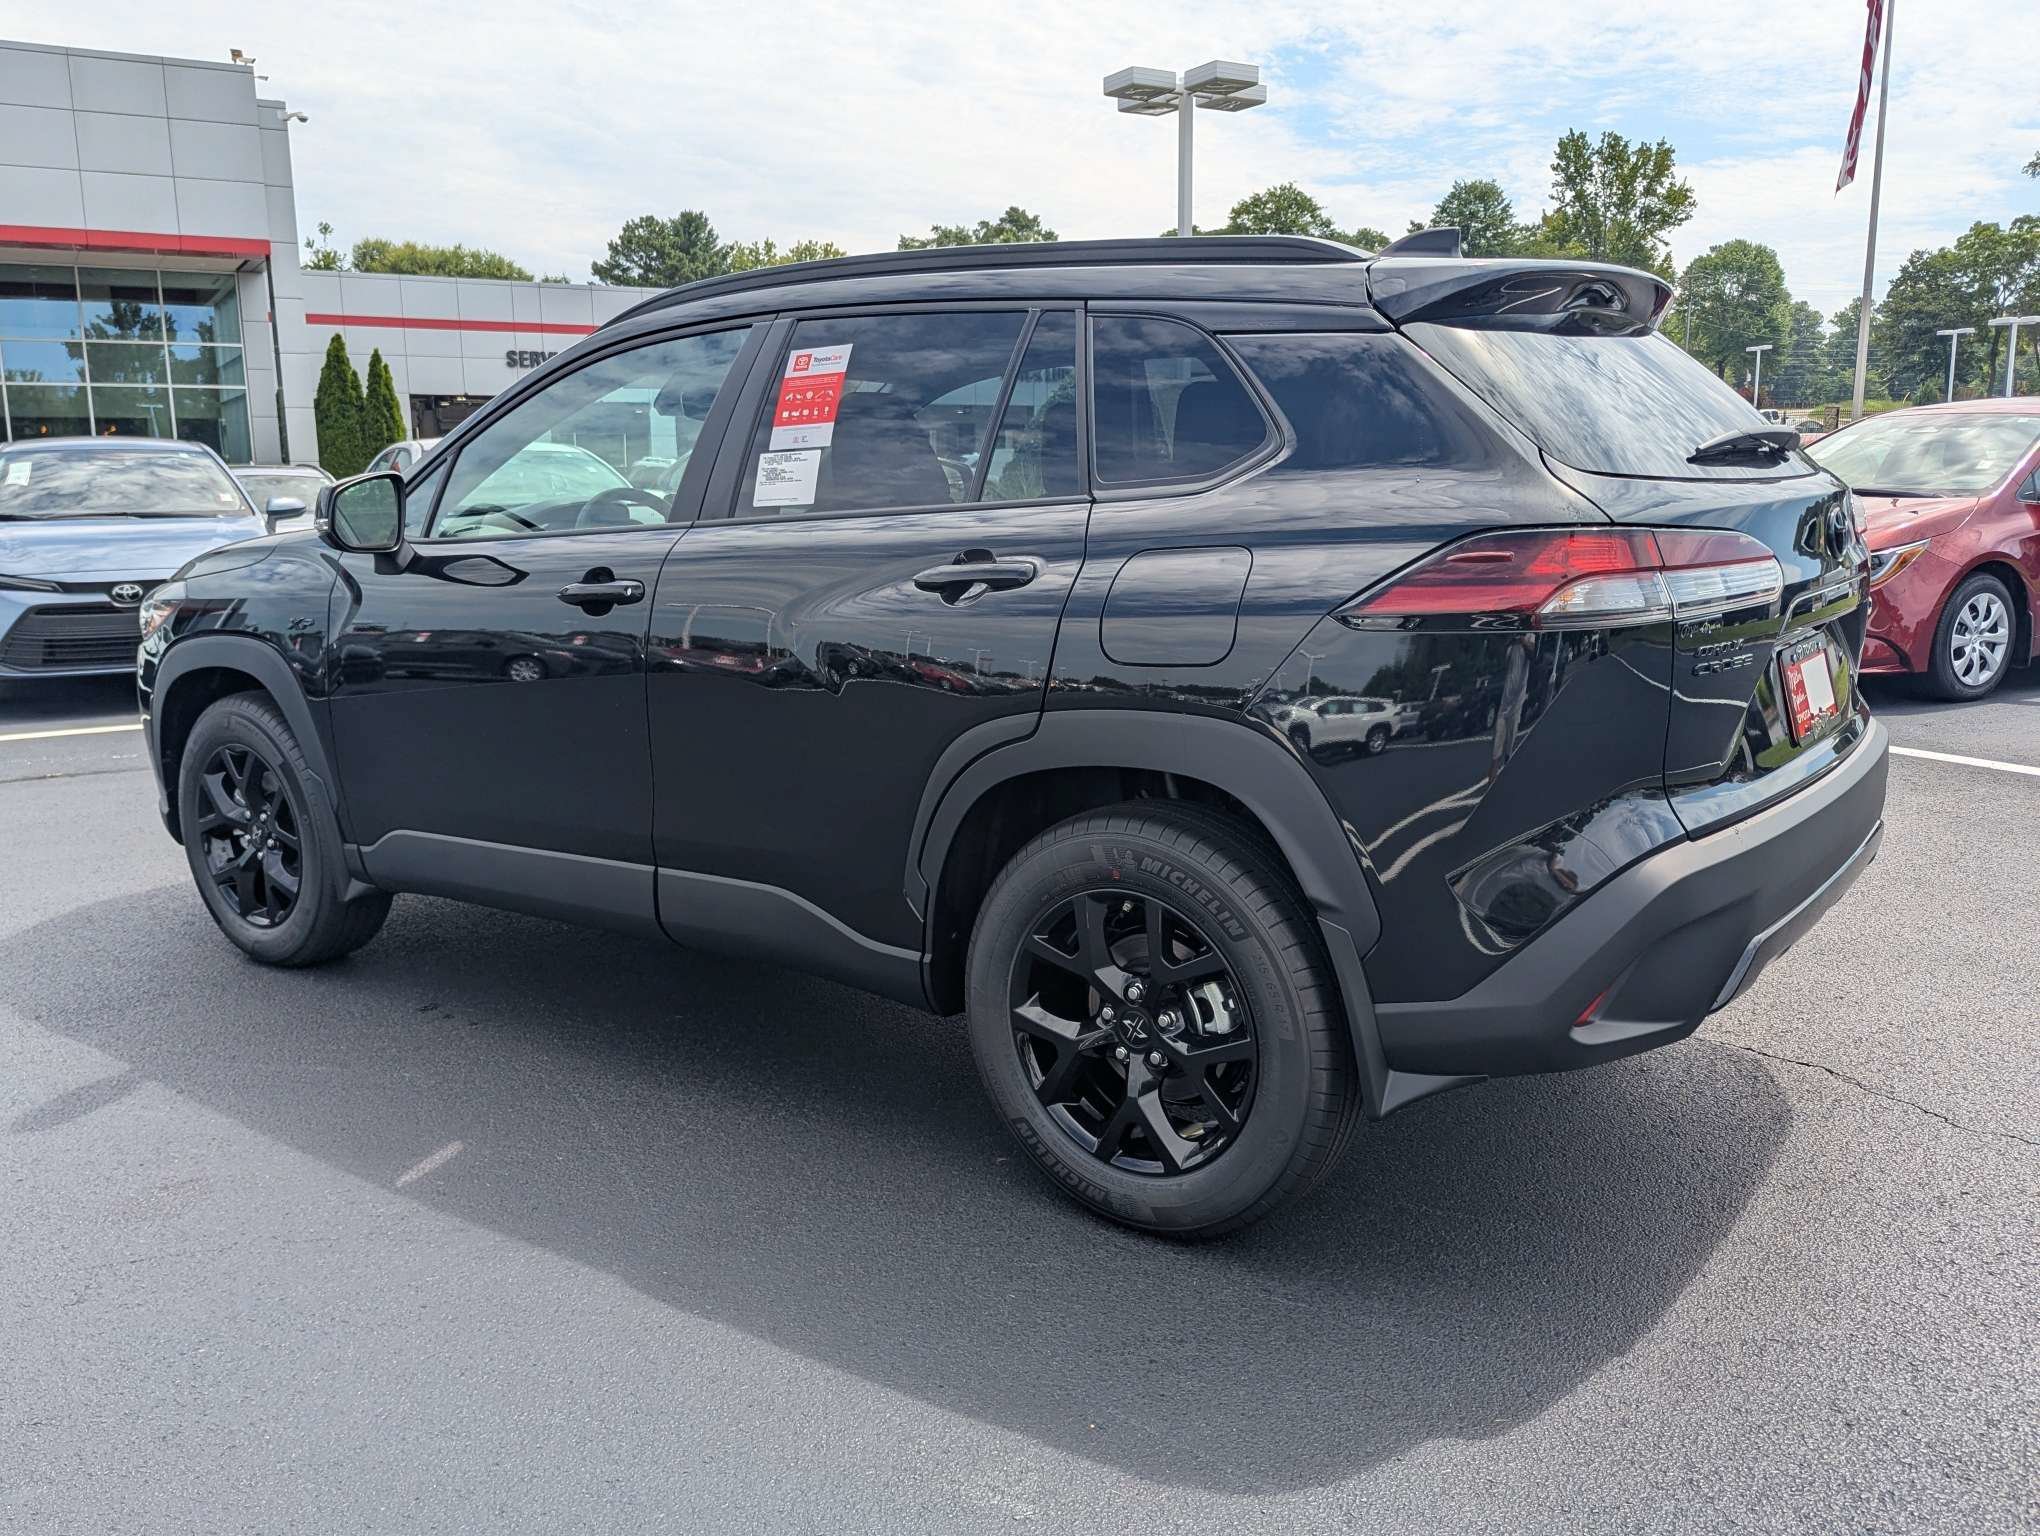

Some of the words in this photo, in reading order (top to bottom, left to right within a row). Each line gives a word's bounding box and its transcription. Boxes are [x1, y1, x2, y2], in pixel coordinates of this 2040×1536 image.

[506, 350, 558, 368] SERV
[1692, 653, 1754, 676] CROSS
[1140, 856, 1244, 938] MICHELIN
[1017, 1120, 1105, 1202] MICHELIN
